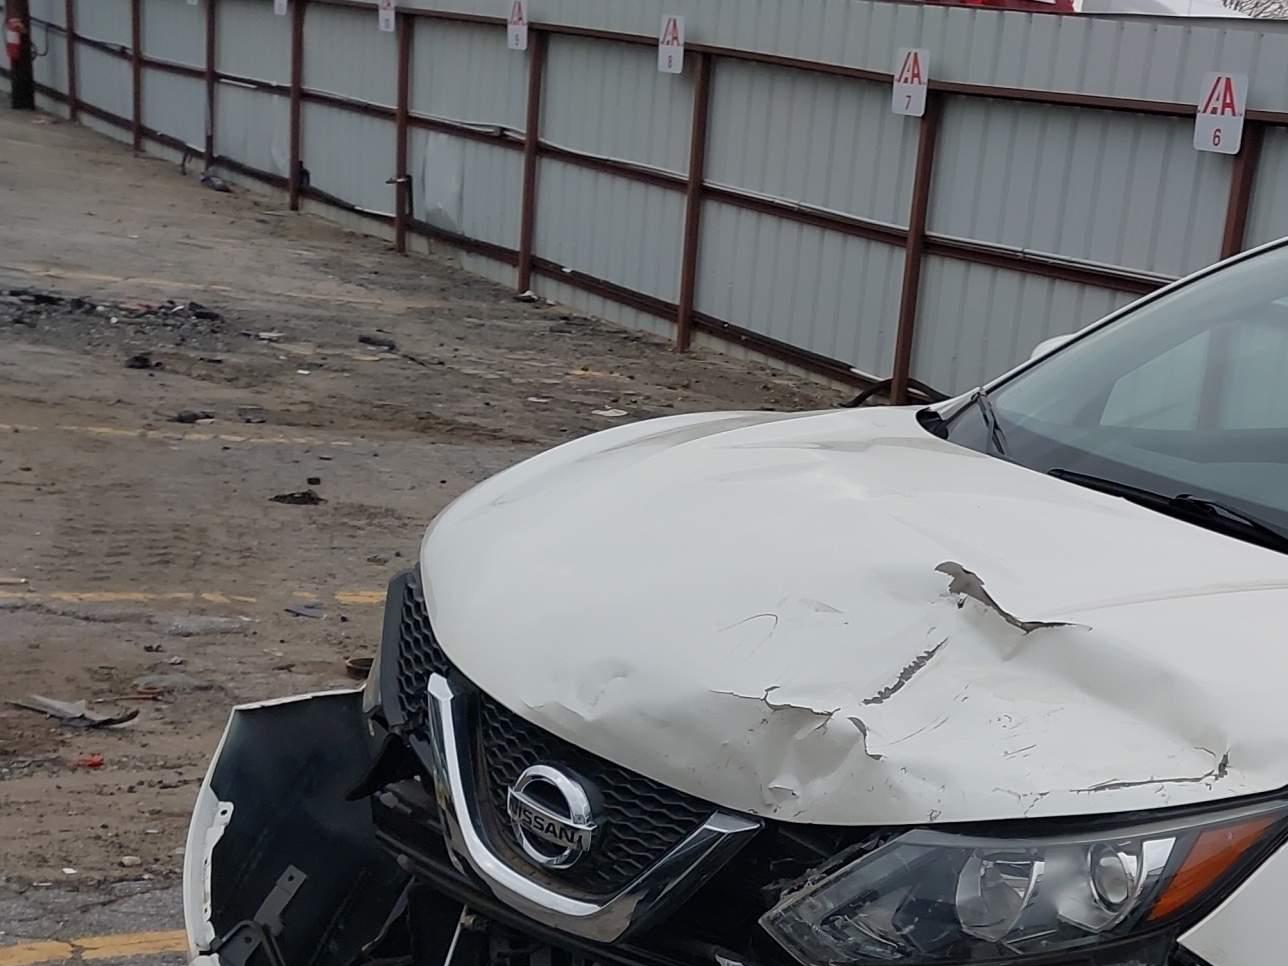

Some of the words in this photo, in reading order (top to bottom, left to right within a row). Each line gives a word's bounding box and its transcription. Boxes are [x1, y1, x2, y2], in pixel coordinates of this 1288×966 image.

[905, 94, 912, 111] 7
[1212, 128, 1222, 146] 6
[510, 799, 583, 849] NISSAN
